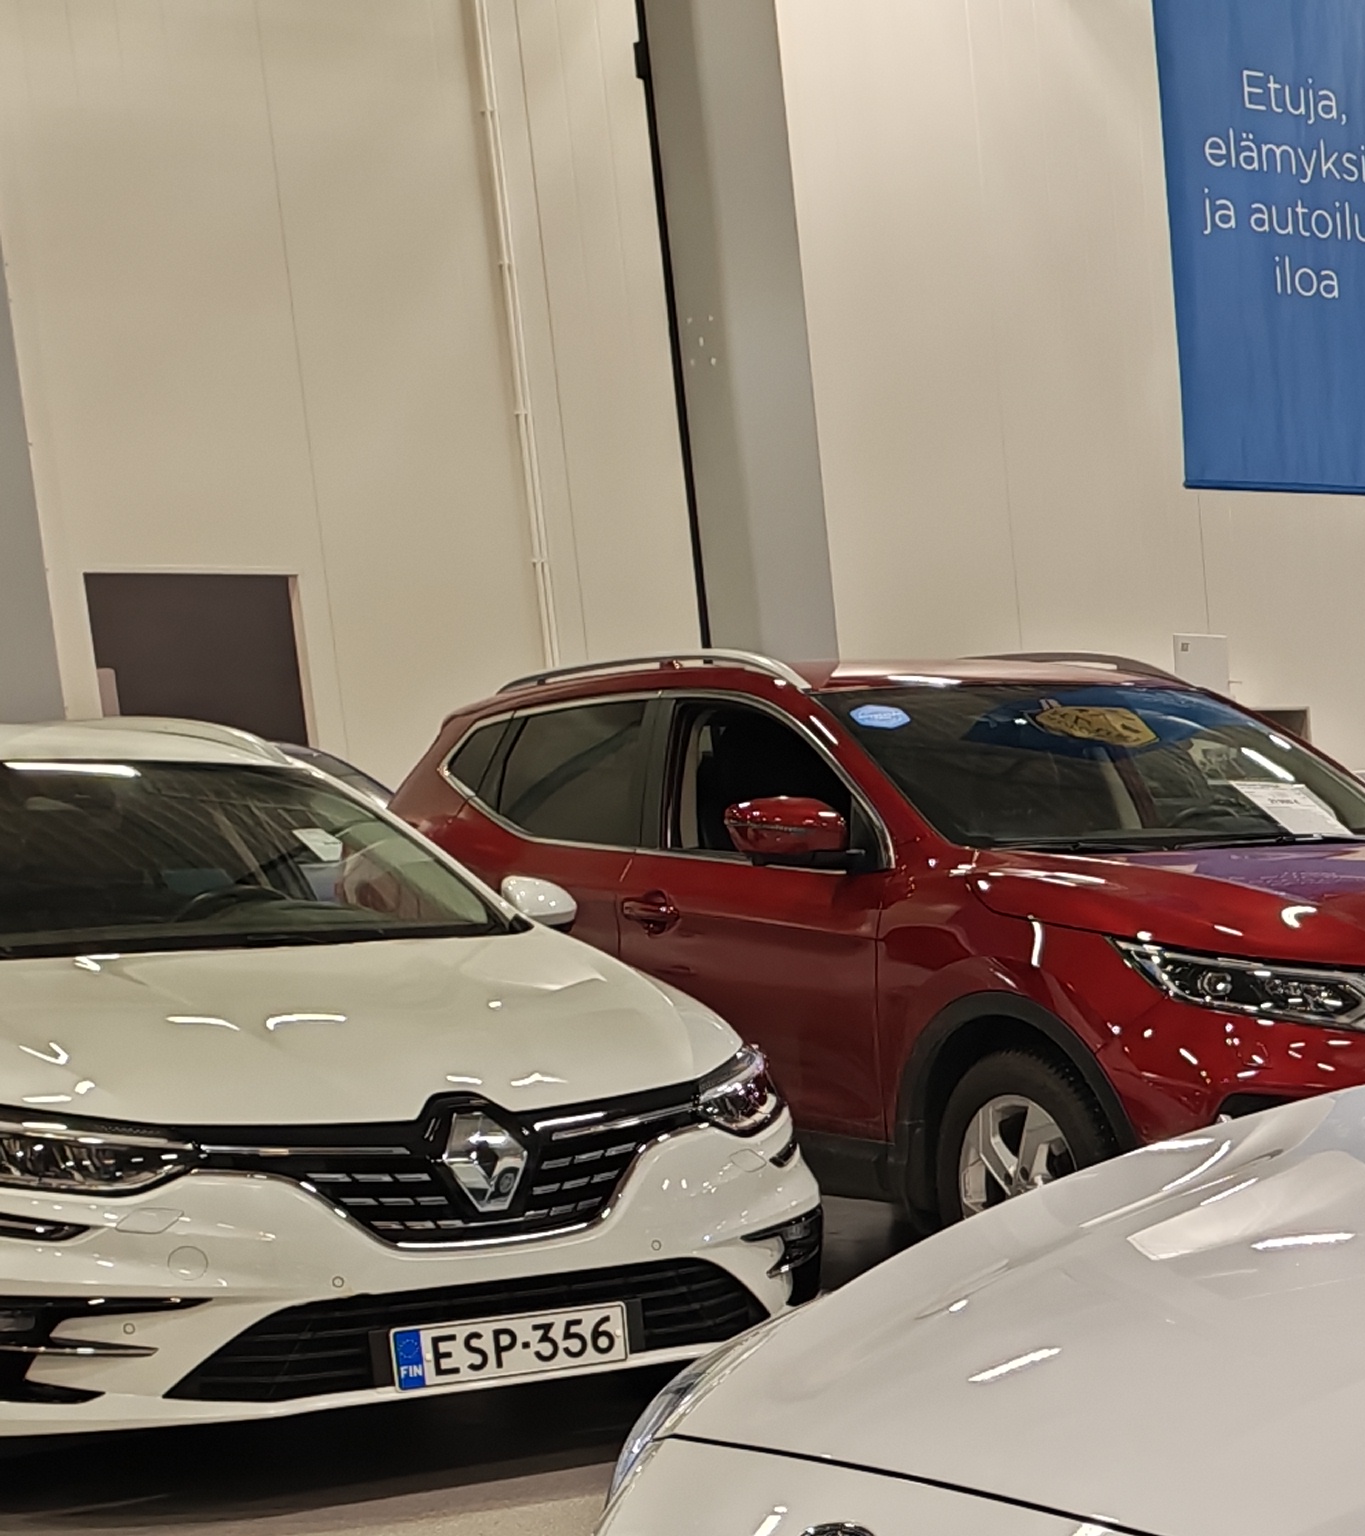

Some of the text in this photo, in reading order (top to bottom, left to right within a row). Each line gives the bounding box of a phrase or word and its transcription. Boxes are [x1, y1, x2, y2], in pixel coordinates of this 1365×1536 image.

[1243, 70, 1347, 126] Etuja,
[1203, 187, 1237, 235] ja
[1274, 255, 1339, 299] iloa
[400, 1363, 423, 1379] FIN
